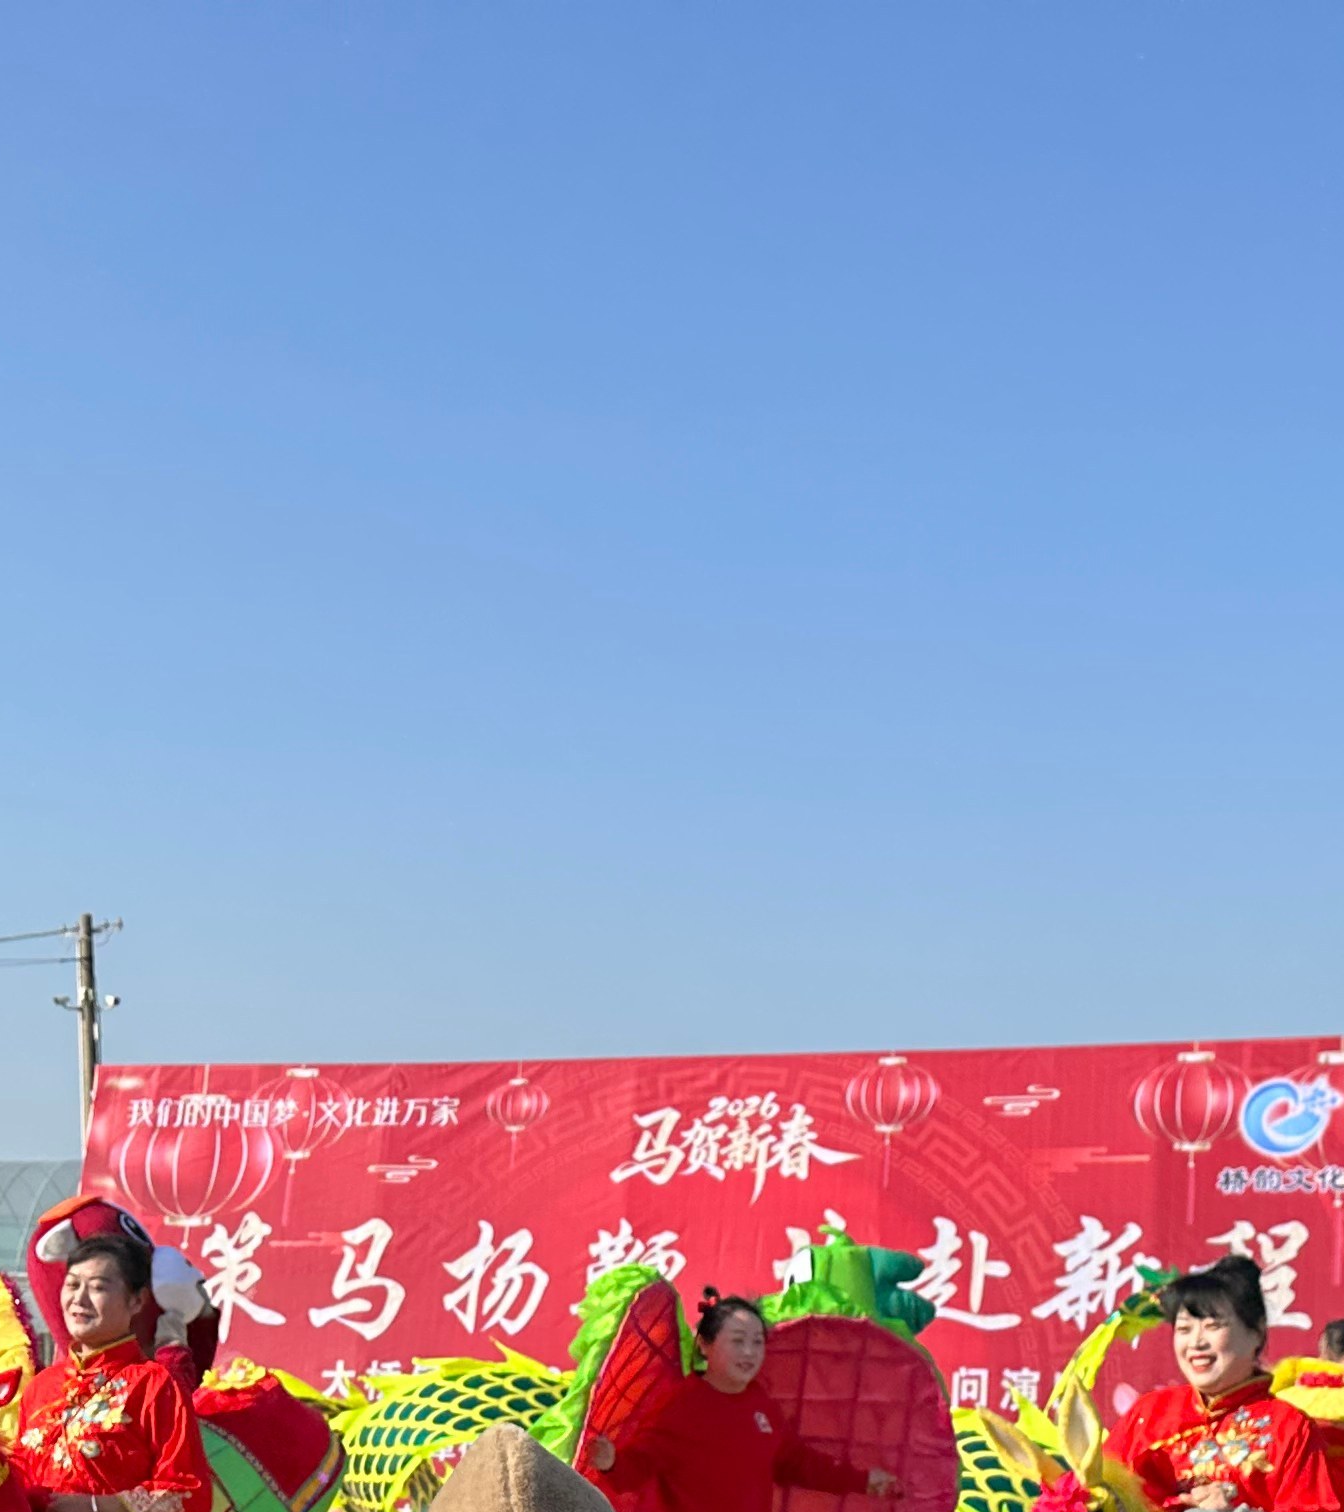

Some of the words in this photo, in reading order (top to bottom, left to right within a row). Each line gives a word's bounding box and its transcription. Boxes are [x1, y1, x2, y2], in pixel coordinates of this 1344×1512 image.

[703, 1091, 781, 1123] 2026
[609, 1103, 864, 1208] 马贺新春
